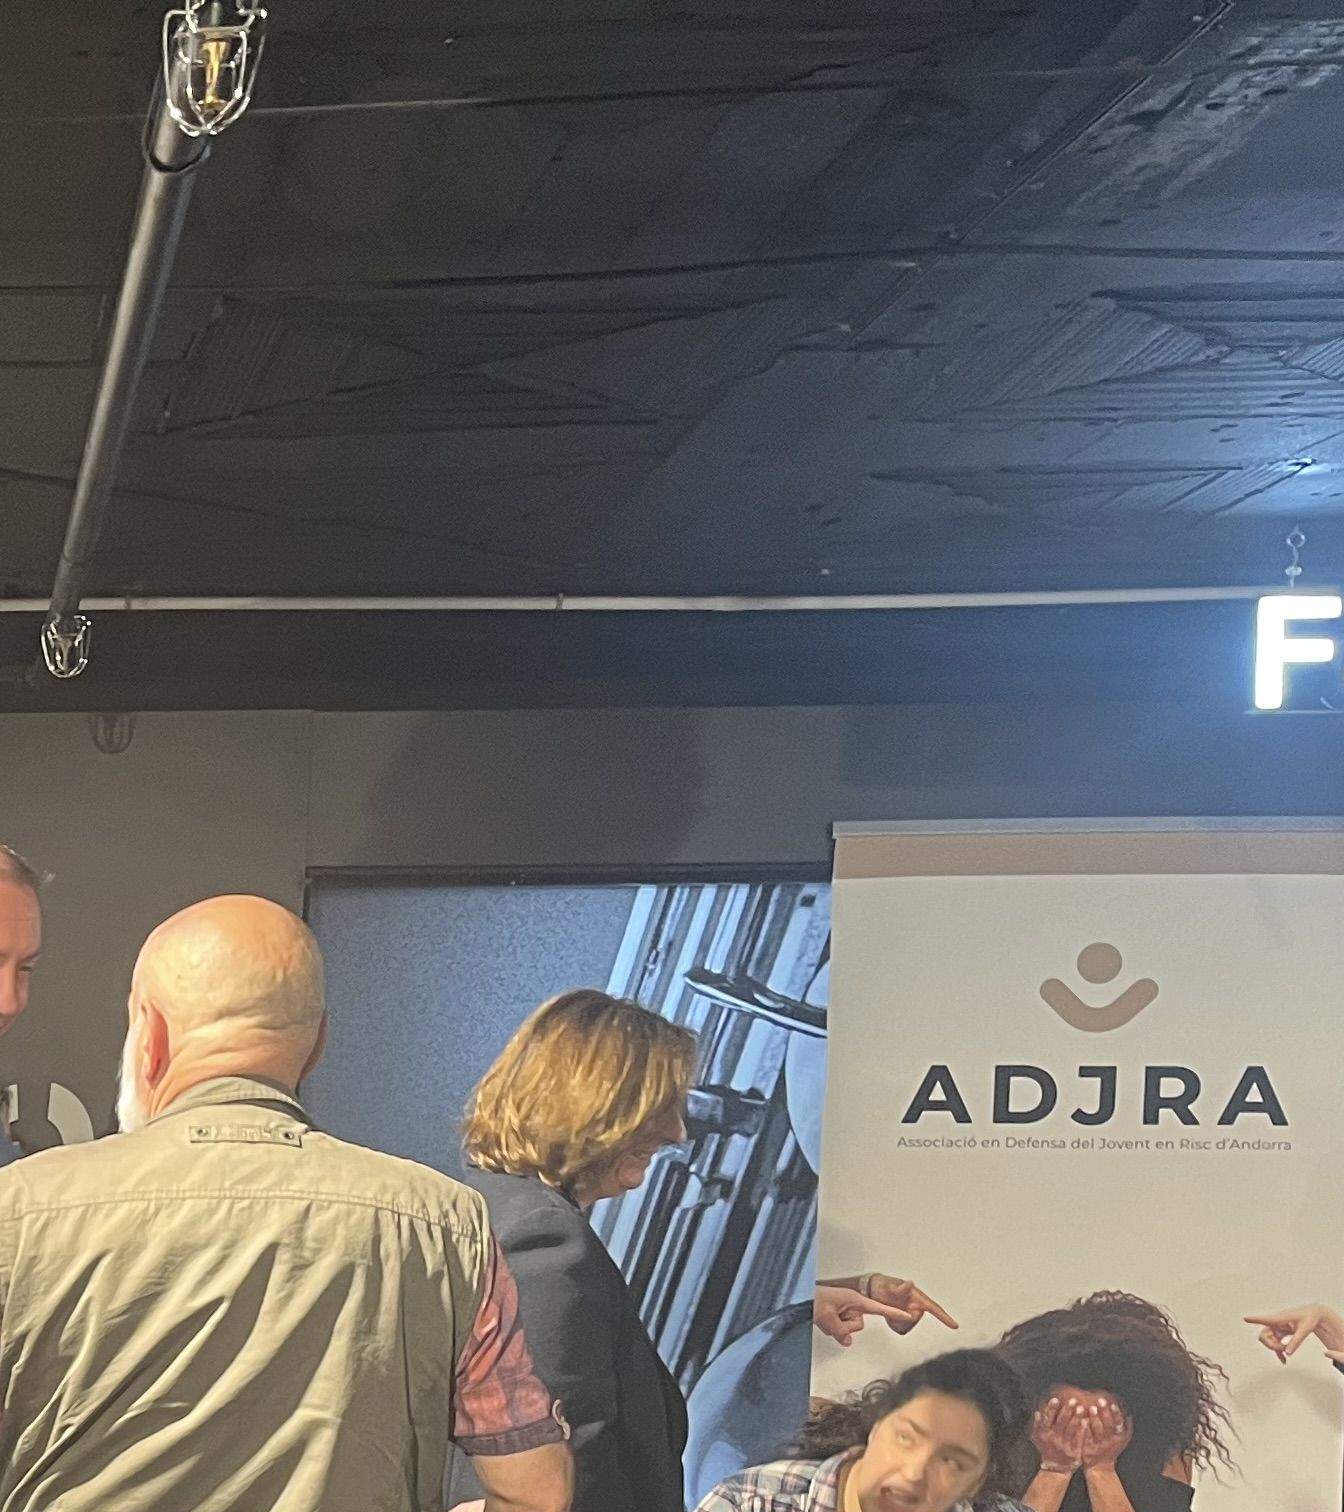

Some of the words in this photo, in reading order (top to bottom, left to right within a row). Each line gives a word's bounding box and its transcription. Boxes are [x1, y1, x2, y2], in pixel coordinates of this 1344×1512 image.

[1254, 595, 1343, 710] F
[900, 1064, 1289, 1127] ADJRA
[896, 1136, 977, 1149] Associació
[981, 1138, 1000, 1149] en
[1005, 1136, 1066, 1149] Defensa
[1070, 1137, 1094, 1150] del
[1098, 1137, 1150, 1150] Jovent
[1155, 1140, 1174, 1150] en
[1179, 1138, 1211, 1150] Risc
[1215, 1138, 1292, 1151] d'Andorra
